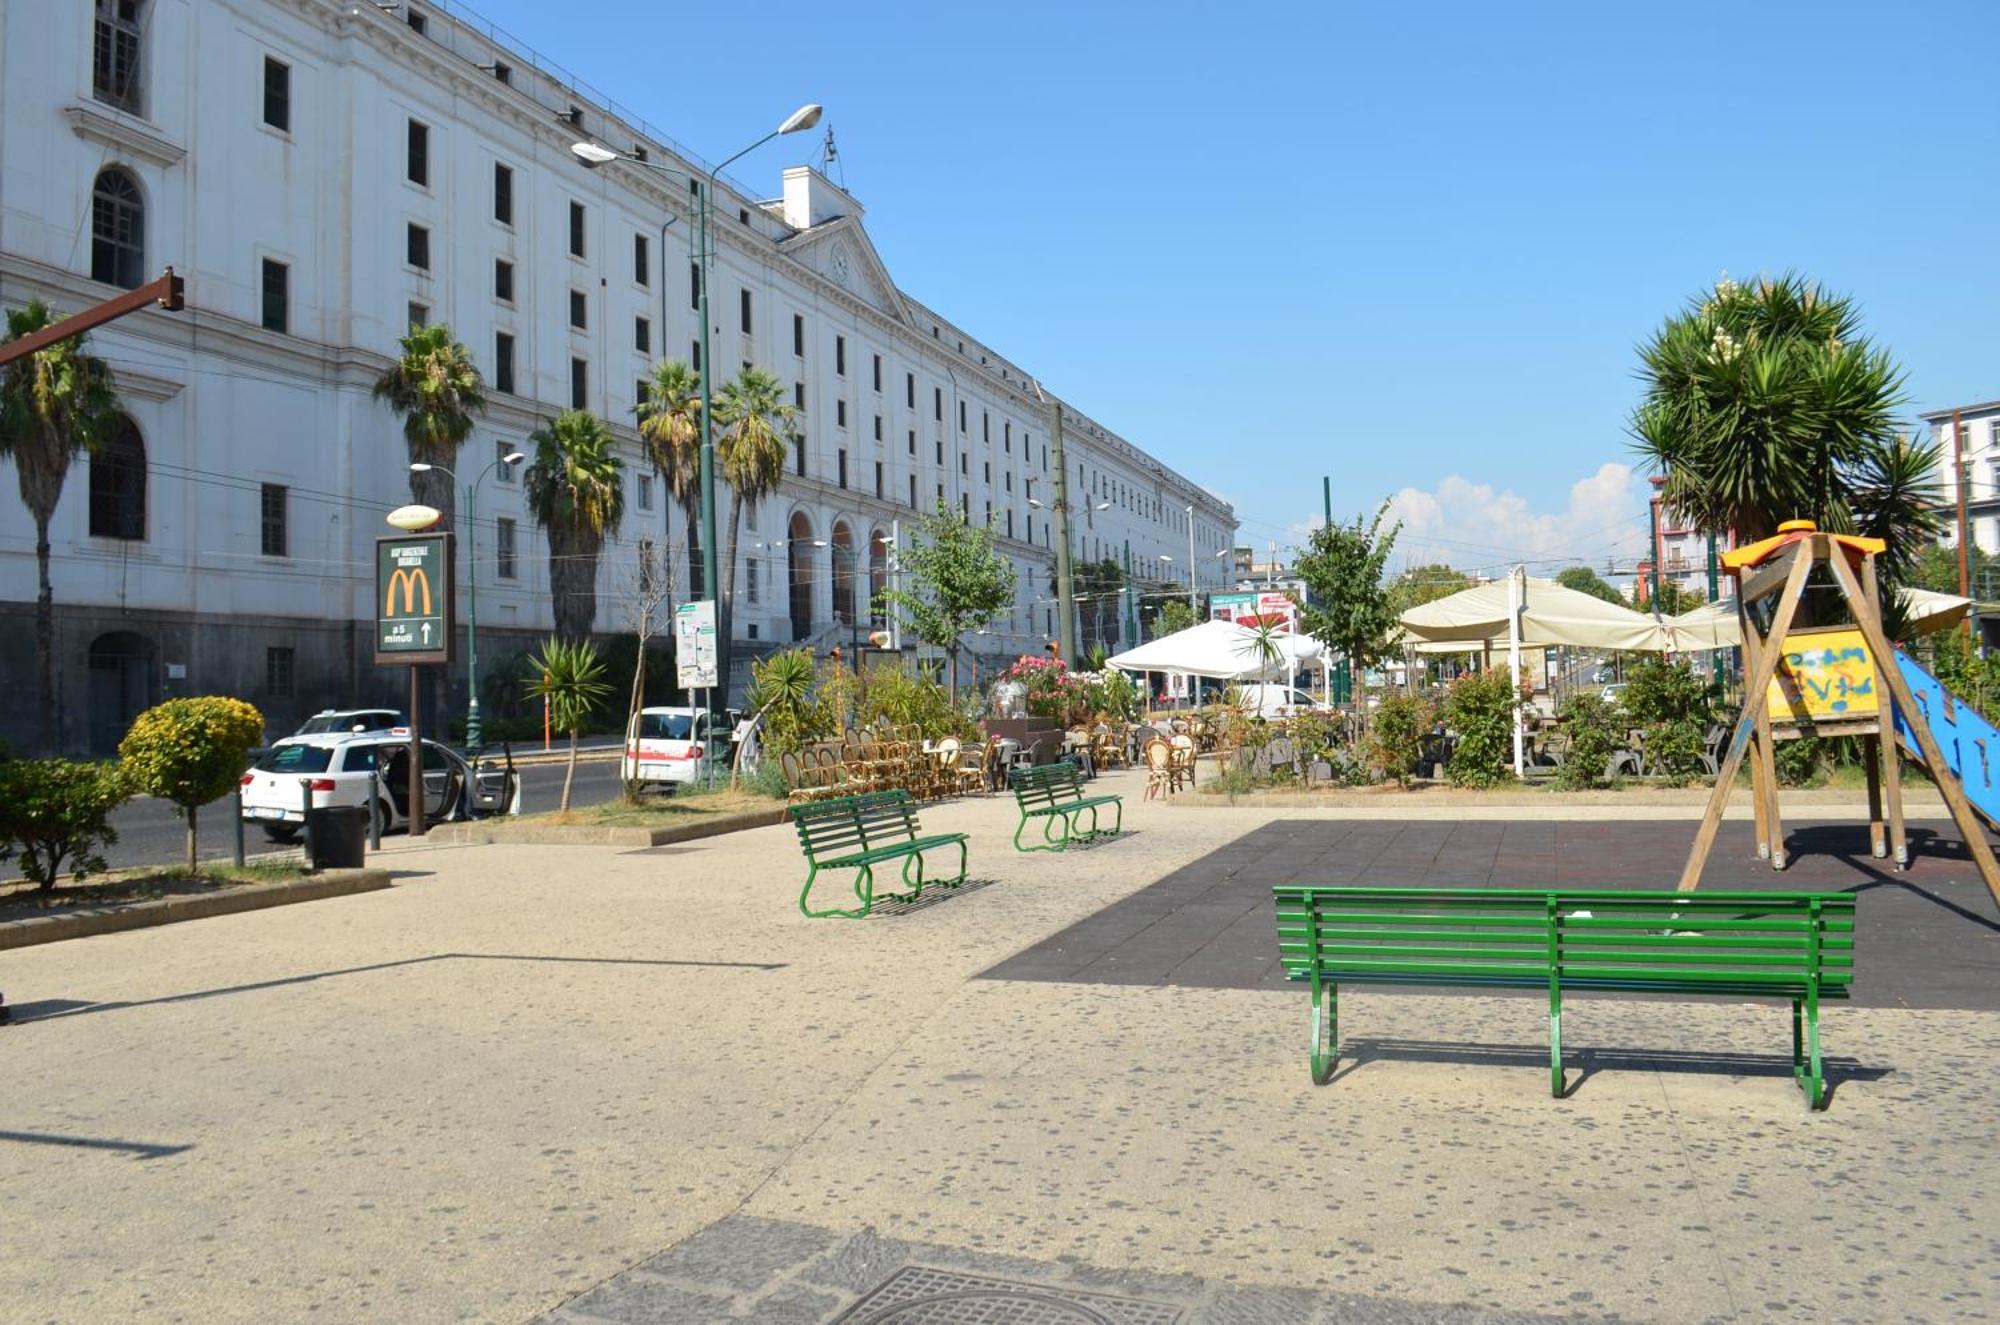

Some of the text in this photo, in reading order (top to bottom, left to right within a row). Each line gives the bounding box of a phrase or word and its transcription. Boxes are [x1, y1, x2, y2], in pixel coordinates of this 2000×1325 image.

[392, 625, 405, 634] a 5
[384, 633, 412, 643] minuti
